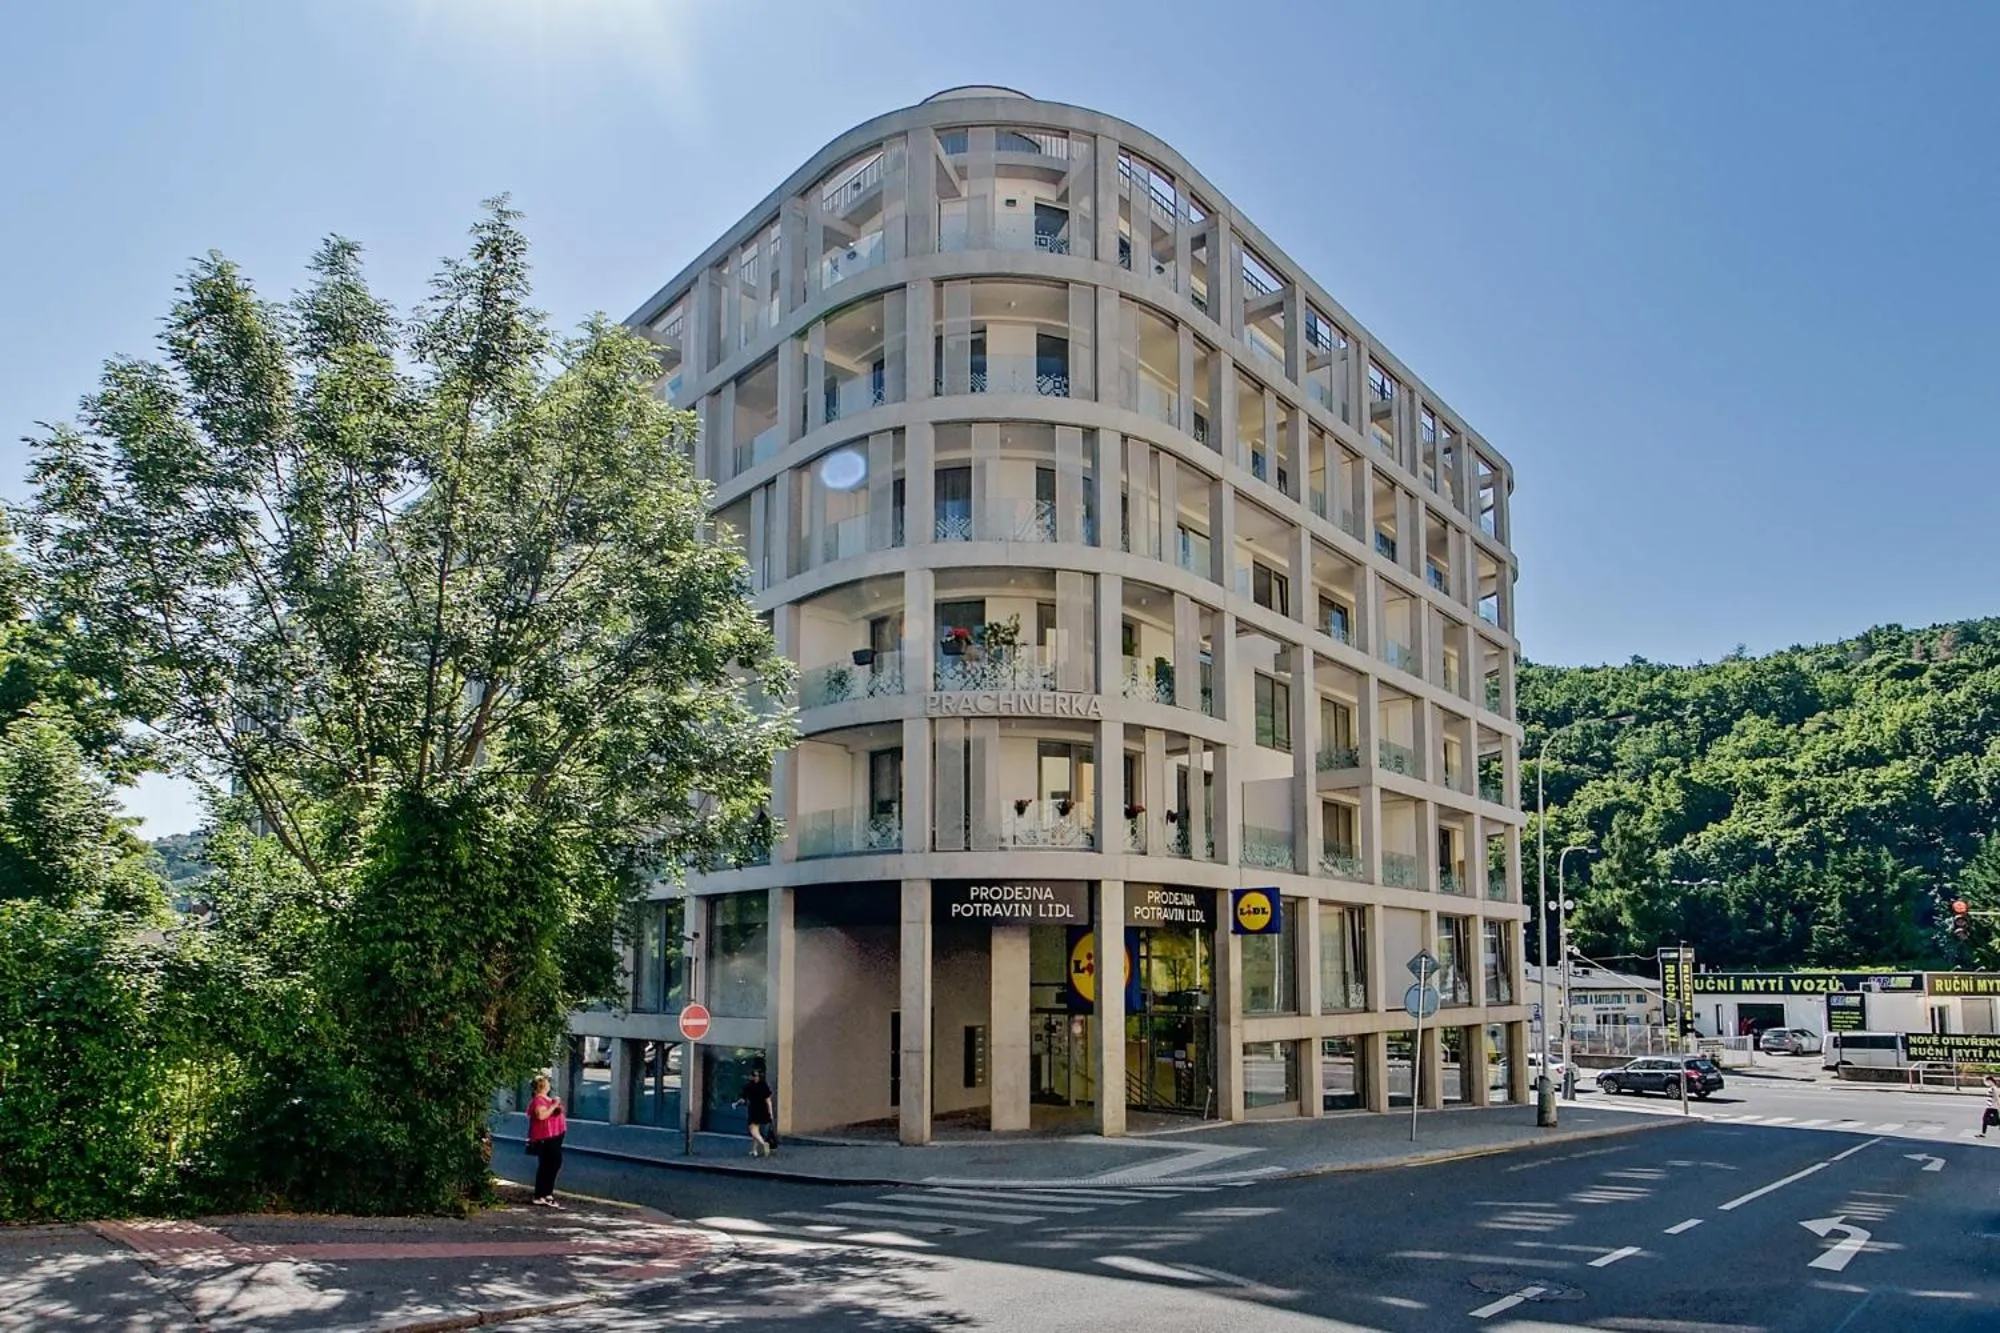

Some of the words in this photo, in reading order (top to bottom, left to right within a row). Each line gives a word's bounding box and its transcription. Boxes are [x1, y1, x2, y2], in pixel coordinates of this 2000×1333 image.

[926, 692, 1103, 717] PRACHNERKA
[970, 886, 1054, 900] PRODEJNA
[1147, 890, 1196, 907] PRODEJNA
[951, 903, 1032, 917] POTRAVIN
[1039, 904, 1074, 917] LIDL
[1134, 906, 1184, 921] POTRAVIN
[1187, 908, 1206, 923] LIDL
[1073, 952, 1094, 977] Li
[1665, 964, 1679, 1003] RUČN
[1694, 976, 1735, 991] UČNÍ
[1741, 976, 1784, 991] MYTÍ
[1790, 976, 1840, 991] VOZŮ
[1935, 976, 1974, 992] RUČNÍ
[1909, 1046, 1949, 1057] RUČNÍ
[1952, 1047, 1983, 1058] MYTÍ
